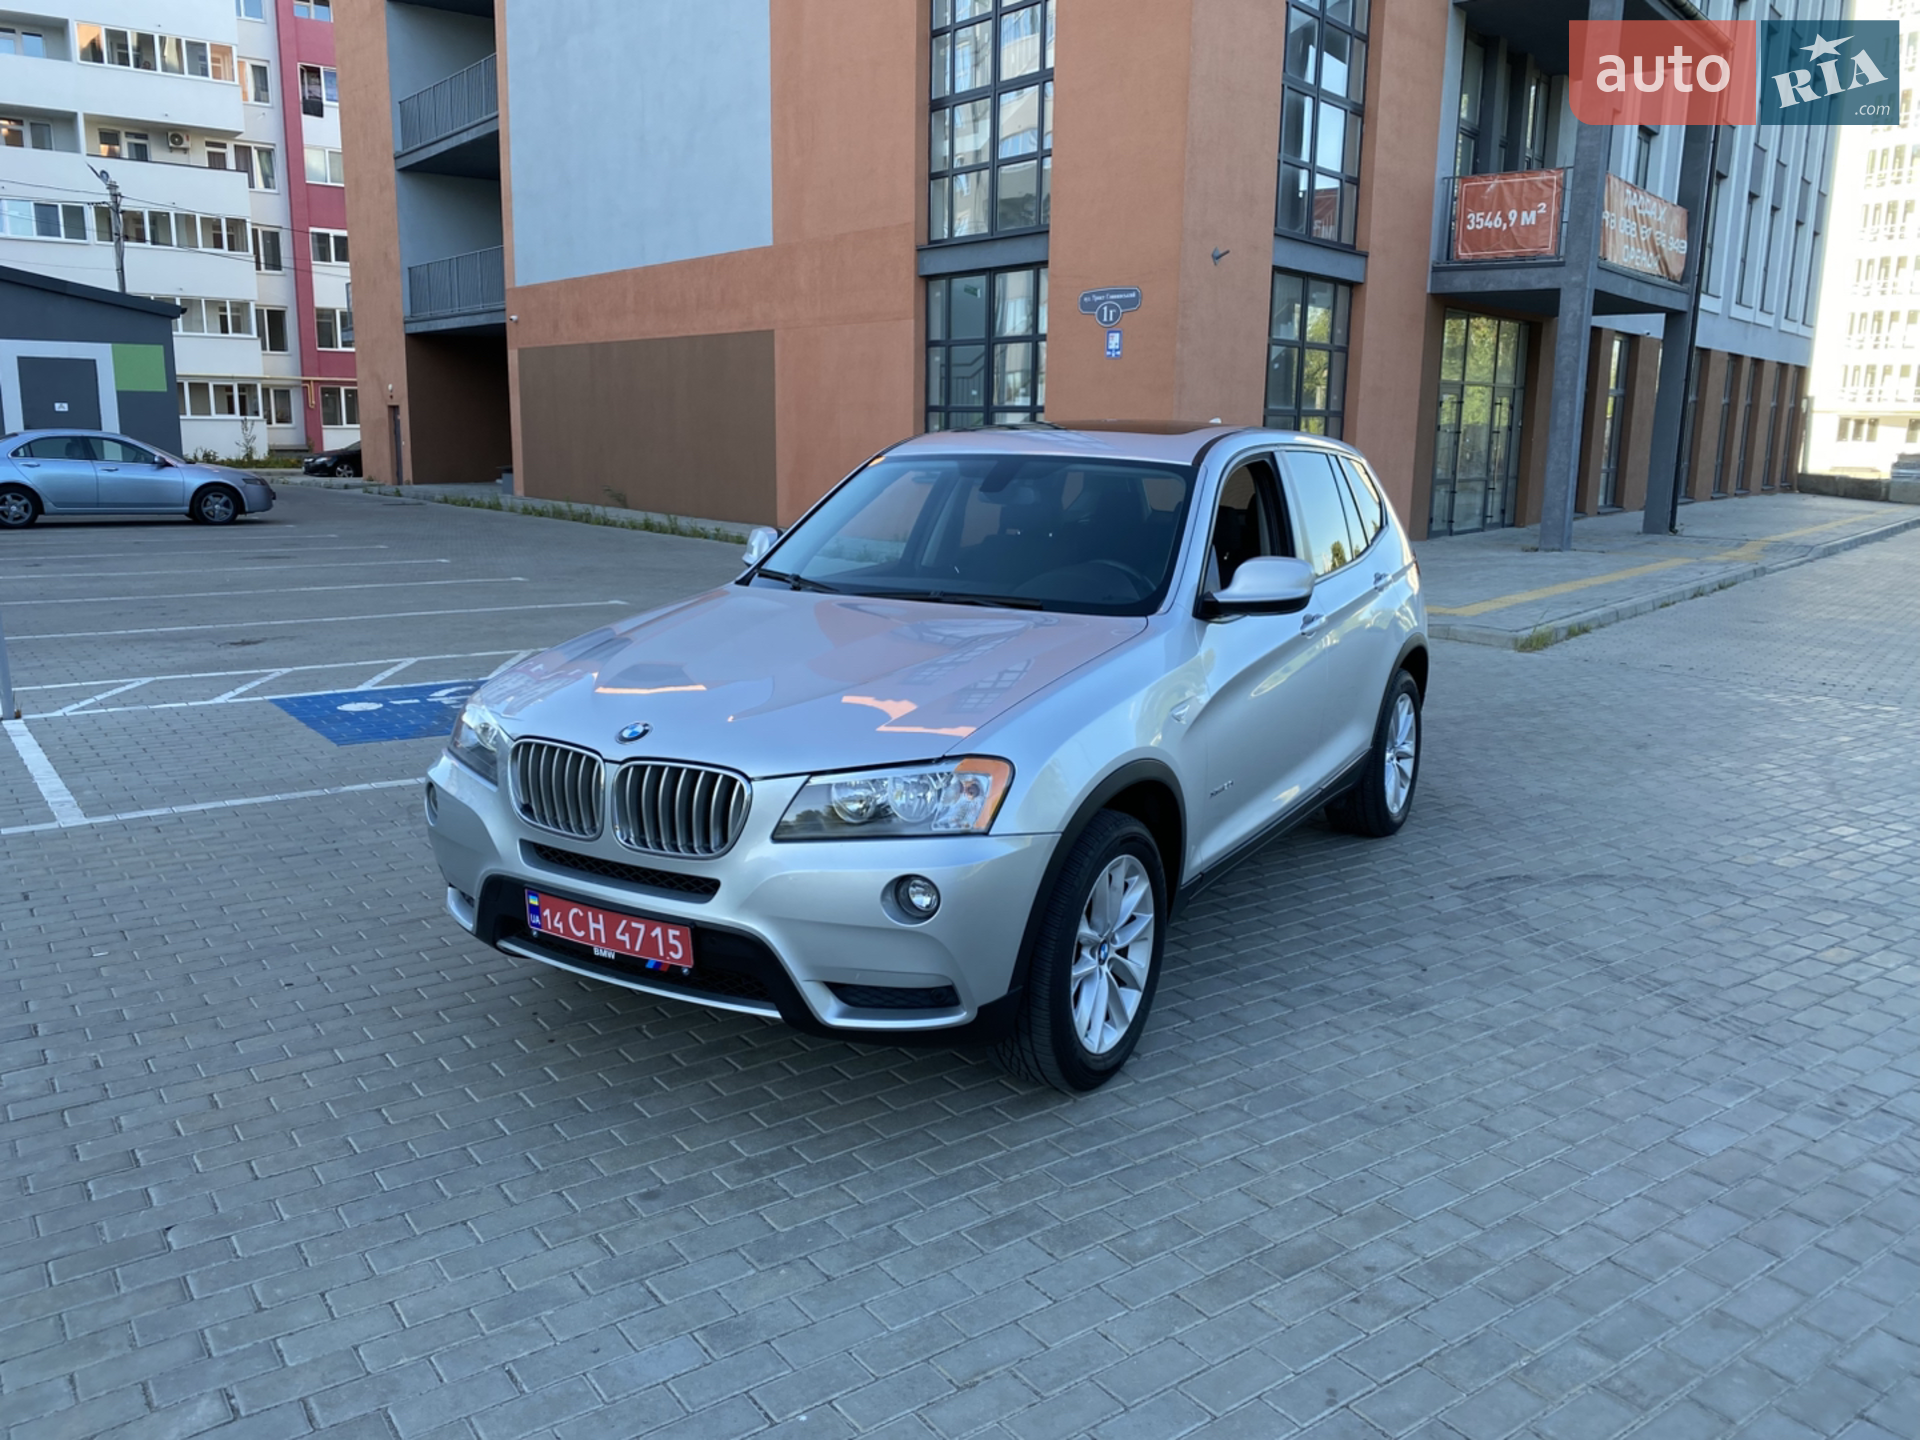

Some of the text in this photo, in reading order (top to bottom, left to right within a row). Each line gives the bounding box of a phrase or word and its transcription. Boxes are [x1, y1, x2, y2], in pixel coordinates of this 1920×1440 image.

[1466, 209, 1517, 231] 3546,9
[530, 913, 541, 925] UA
[615, 919, 684, 961] 4715
[592, 946, 616, 960] BMW
